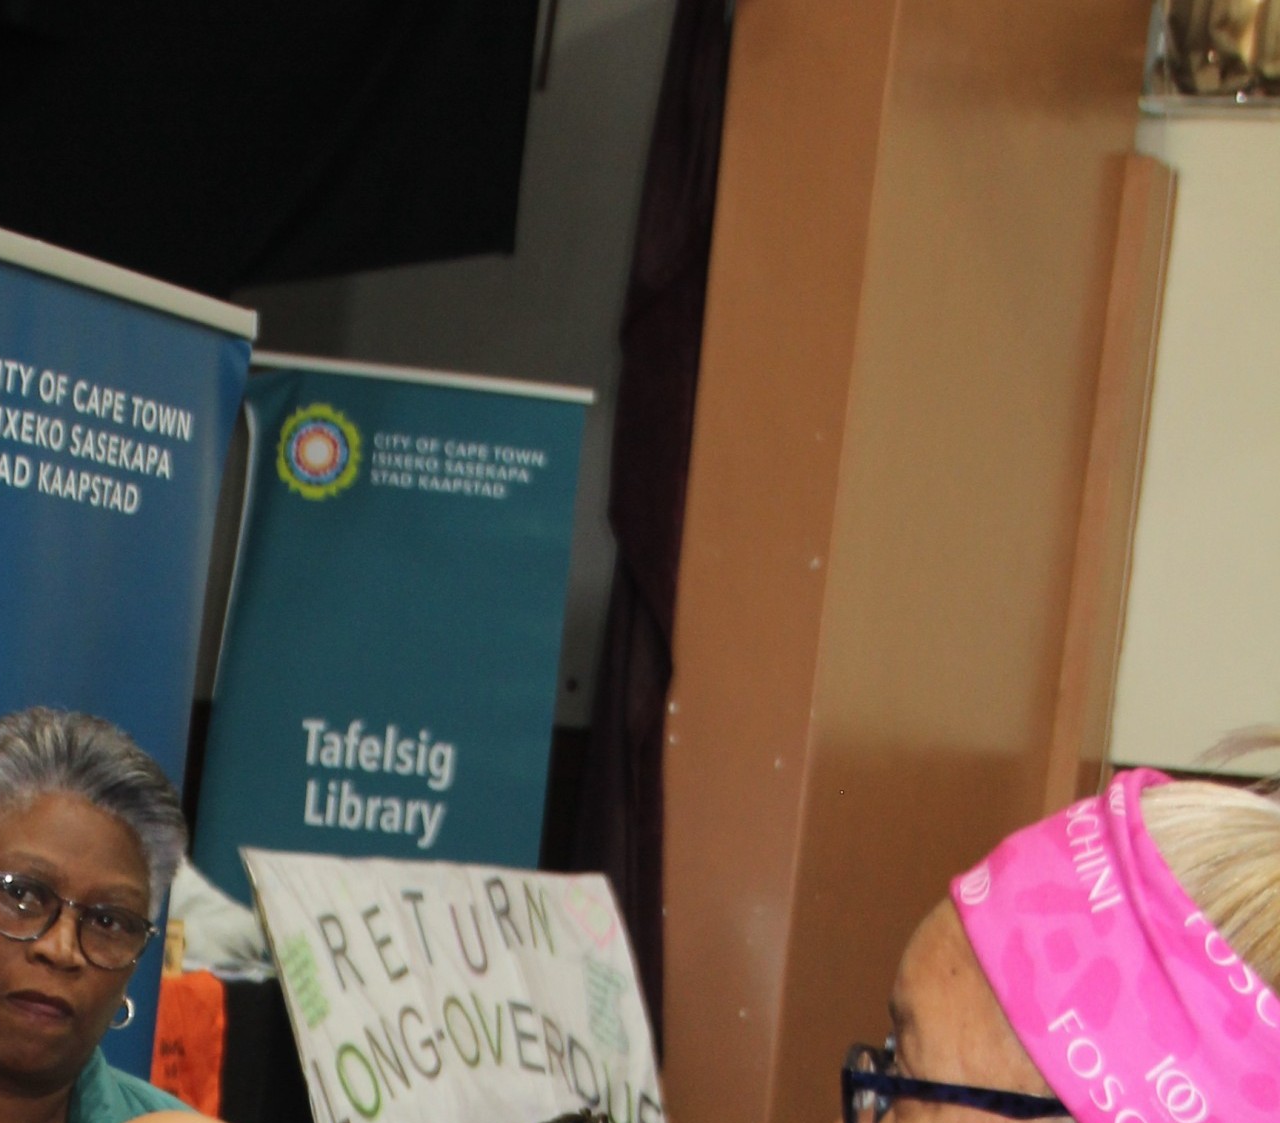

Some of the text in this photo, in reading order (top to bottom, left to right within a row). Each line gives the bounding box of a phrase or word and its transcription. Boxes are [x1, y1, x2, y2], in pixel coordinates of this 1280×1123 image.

[39, 371, 69, 405] OF
[73, 380, 126, 421] CAPE
[132, 397, 193, 442] TOWN
[70, 425, 173, 480] SASEKAPA
[372, 451, 530, 483] ISIXEKO SASEKAPA
[373, 432, 546, 468] CITY OF CAPE TOWN
[37, 462, 141, 515] KAAPSTAD
[371, 470, 506, 499] STAD KAAPSTAD
[303, 719, 456, 791] Tafelsig
[304, 780, 445, 849] Library
[317, 876, 557, 992] RETURN
